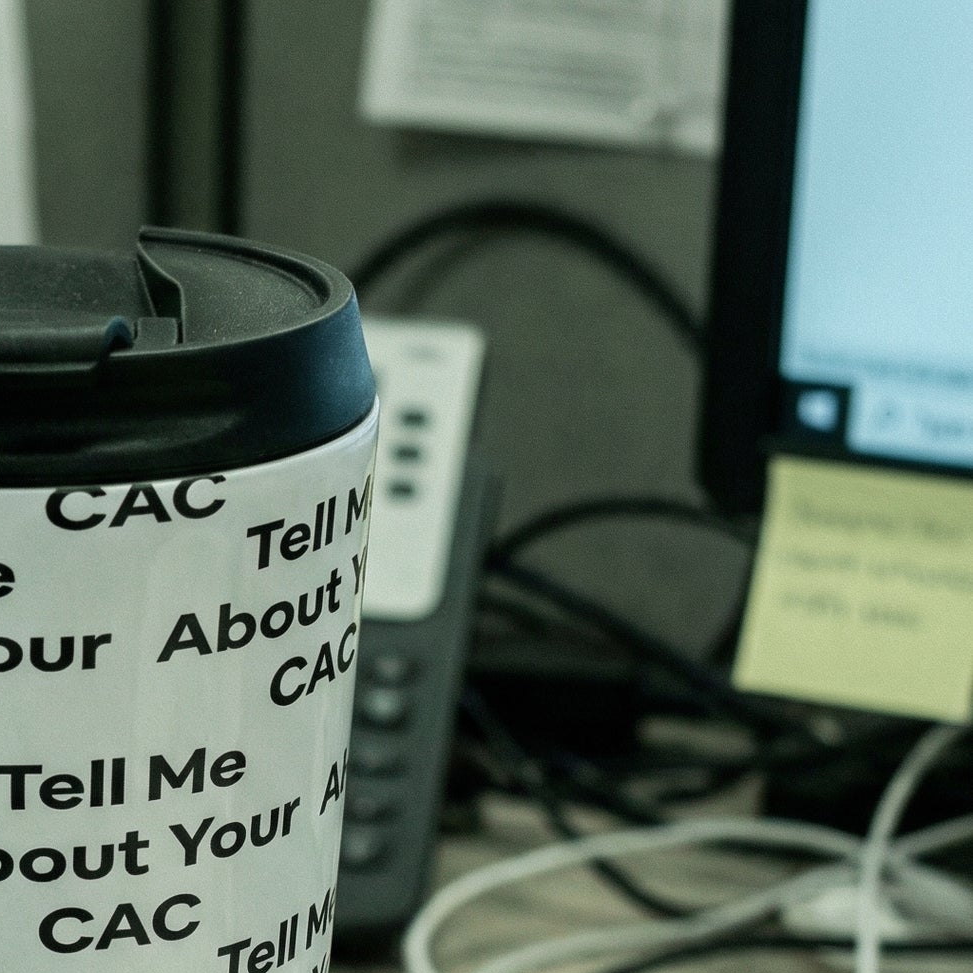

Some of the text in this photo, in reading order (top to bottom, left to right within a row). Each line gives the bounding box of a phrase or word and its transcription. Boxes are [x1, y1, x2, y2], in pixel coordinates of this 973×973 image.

[44, 474, 227, 532] CAC
[246, 495, 337, 571] Tell
[155, 567, 343, 664] About
[269, 621, 358, 707] CAC
[147, 747, 247, 802] Me
[168, 796, 301, 867] Your
[38, 893, 202, 954] CAC
